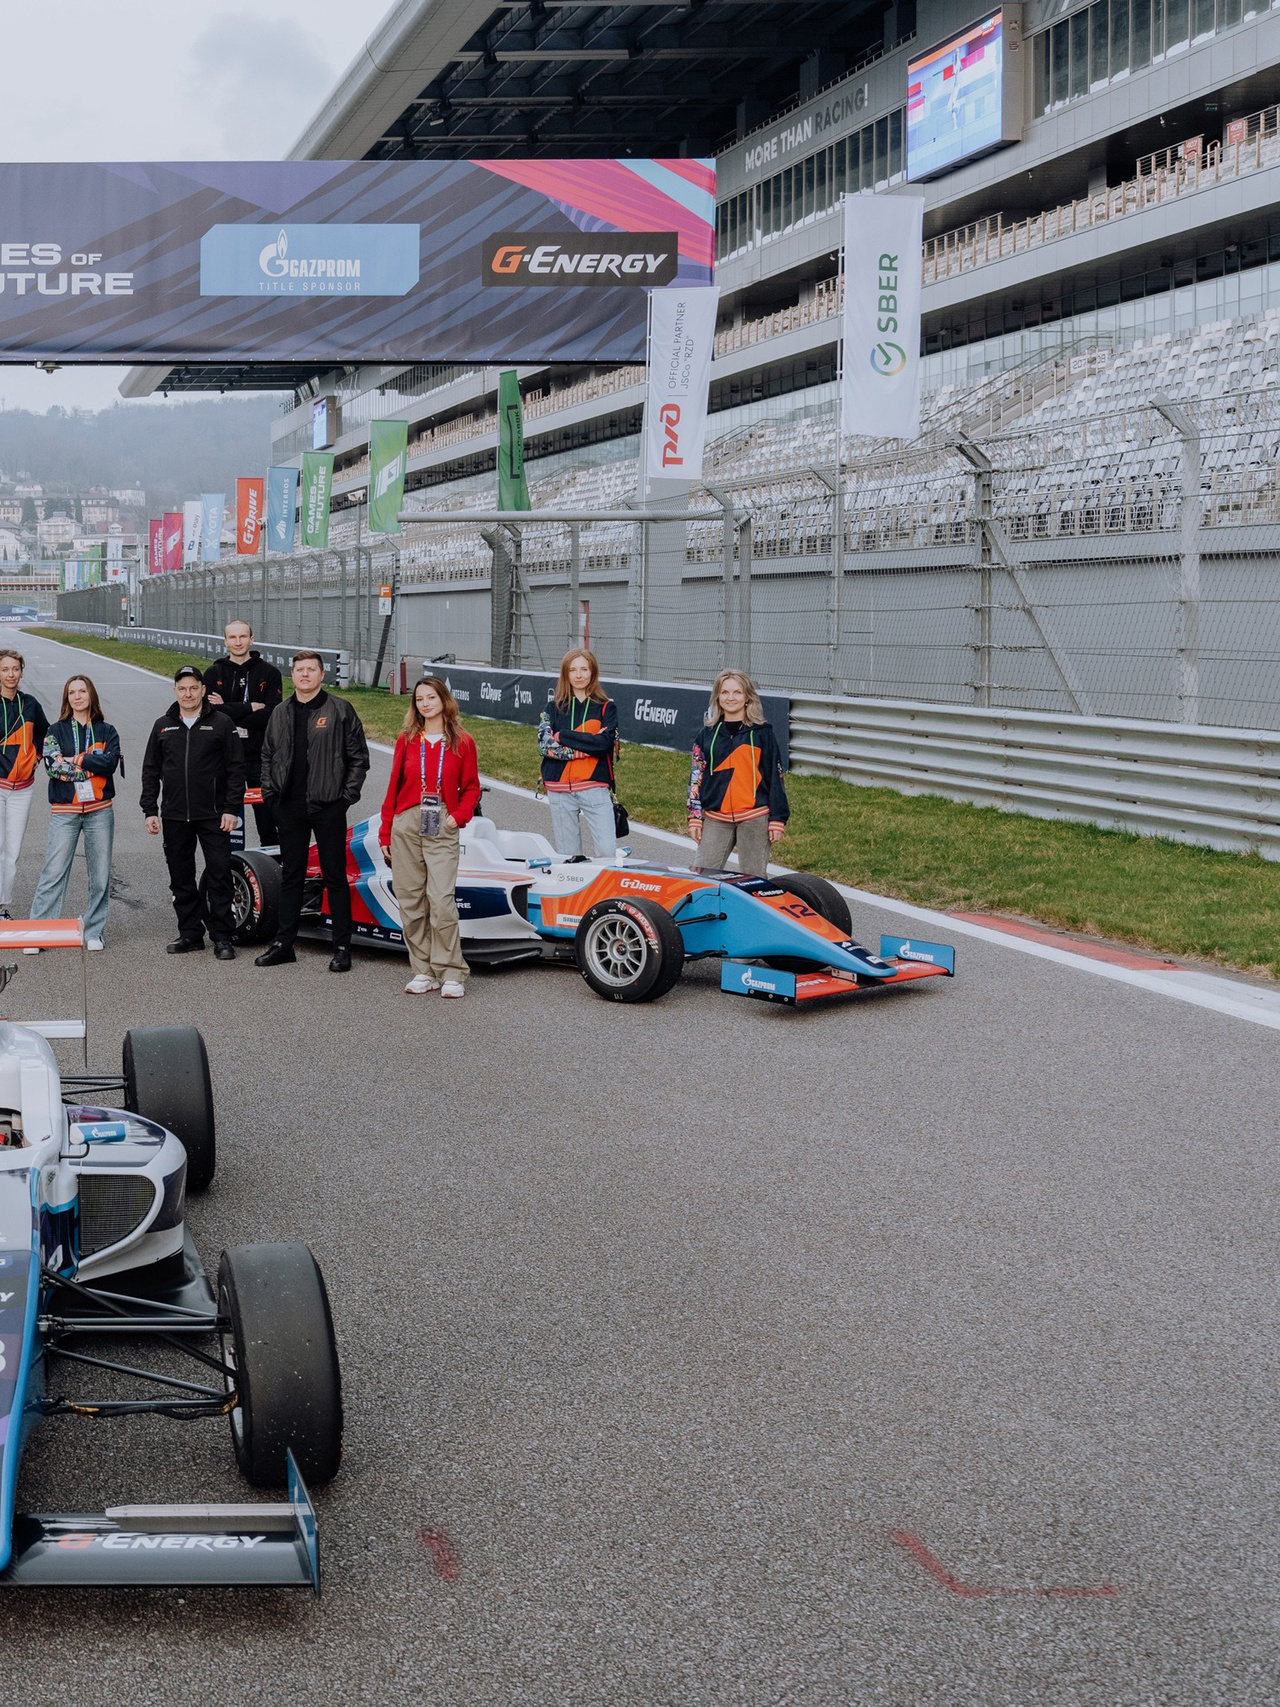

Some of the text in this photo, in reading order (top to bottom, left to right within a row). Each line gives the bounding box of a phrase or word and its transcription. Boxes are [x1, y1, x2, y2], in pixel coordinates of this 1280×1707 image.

[745, 83, 869, 173] MORE THAN RACING!
[70, 253, 102, 266] OF
[289, 259, 361, 278] GAZPROM
[490, 245, 669, 278] G-ENERGY
[259, 282, 361, 291] TITLE SPONSOR
[876, 252, 899, 334] SBER
[668, 301, 687, 390] OFFICIAL PARTNER
[282, 478, 290, 518] INTERROS
[316, 466, 327, 520] FUTURE
[306, 484, 317, 534] GAMES
[380, 586, 390, 596] F
[566, 875, 585, 883] SBER
[779, 904, 819, 919] 12
[58, 1532, 267, 1552] G-ENERGY
